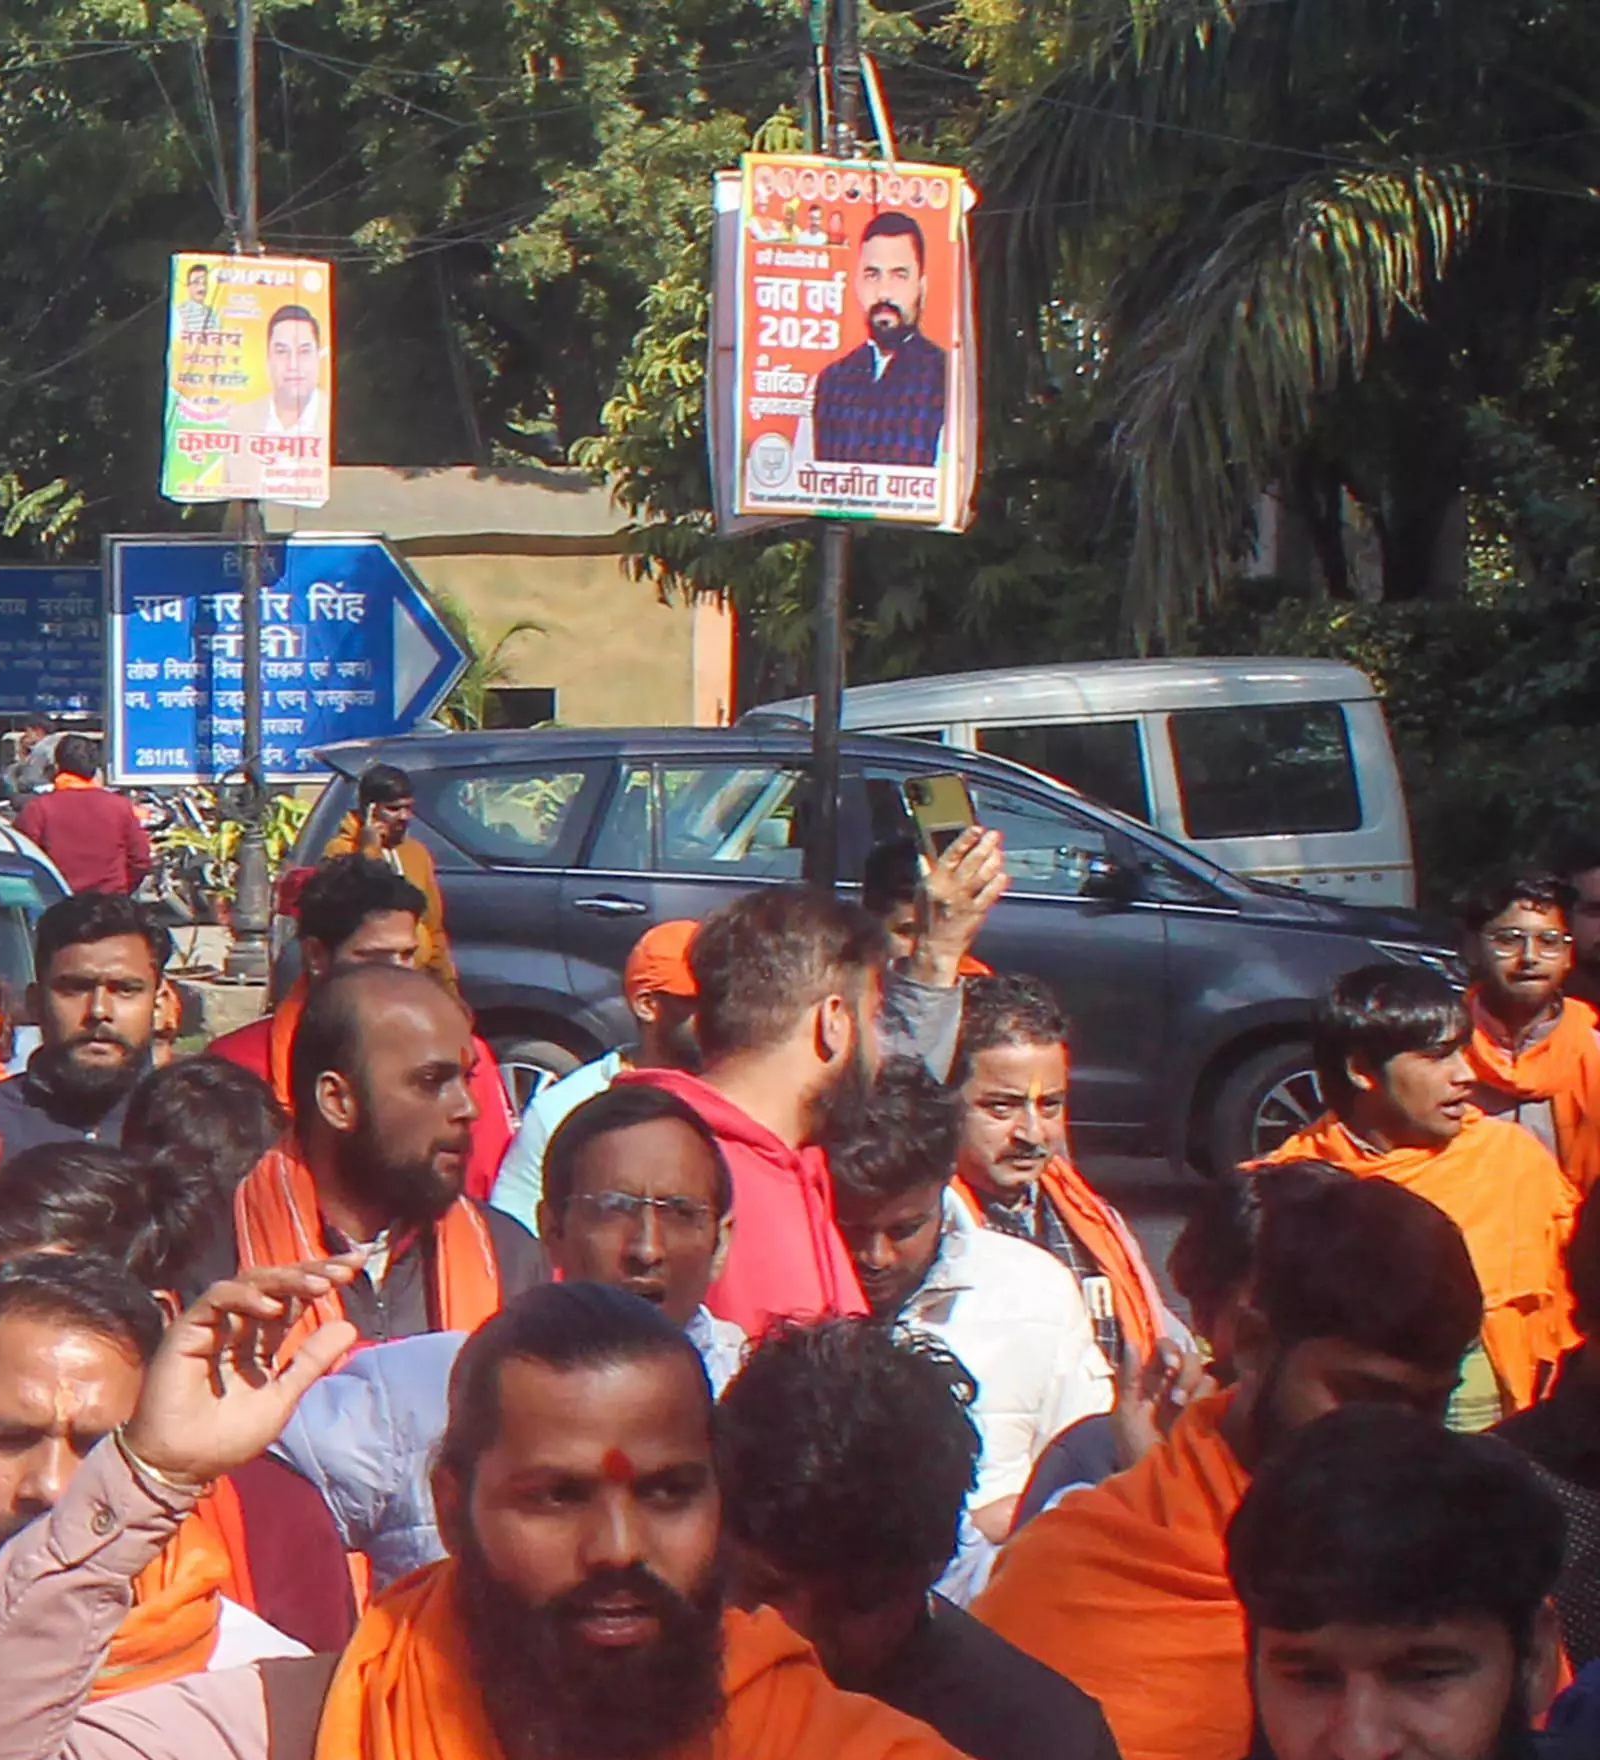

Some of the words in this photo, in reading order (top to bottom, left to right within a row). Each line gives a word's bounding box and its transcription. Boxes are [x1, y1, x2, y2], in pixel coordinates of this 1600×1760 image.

[754, 276, 800, 311] नव
[803, 271, 847, 314] वर्ष
[757, 316, 840, 350] 2023
[752, 363, 807, 393] हार्दिक
[178, 431, 240, 462] कृष्ण
[248, 432, 322, 465] कुमार
[797, 463, 880, 496] पोलजीत
[886, 474, 937, 499] यादव
[133, 594, 182, 622] राव
[306, 582, 366, 623] सिंह
